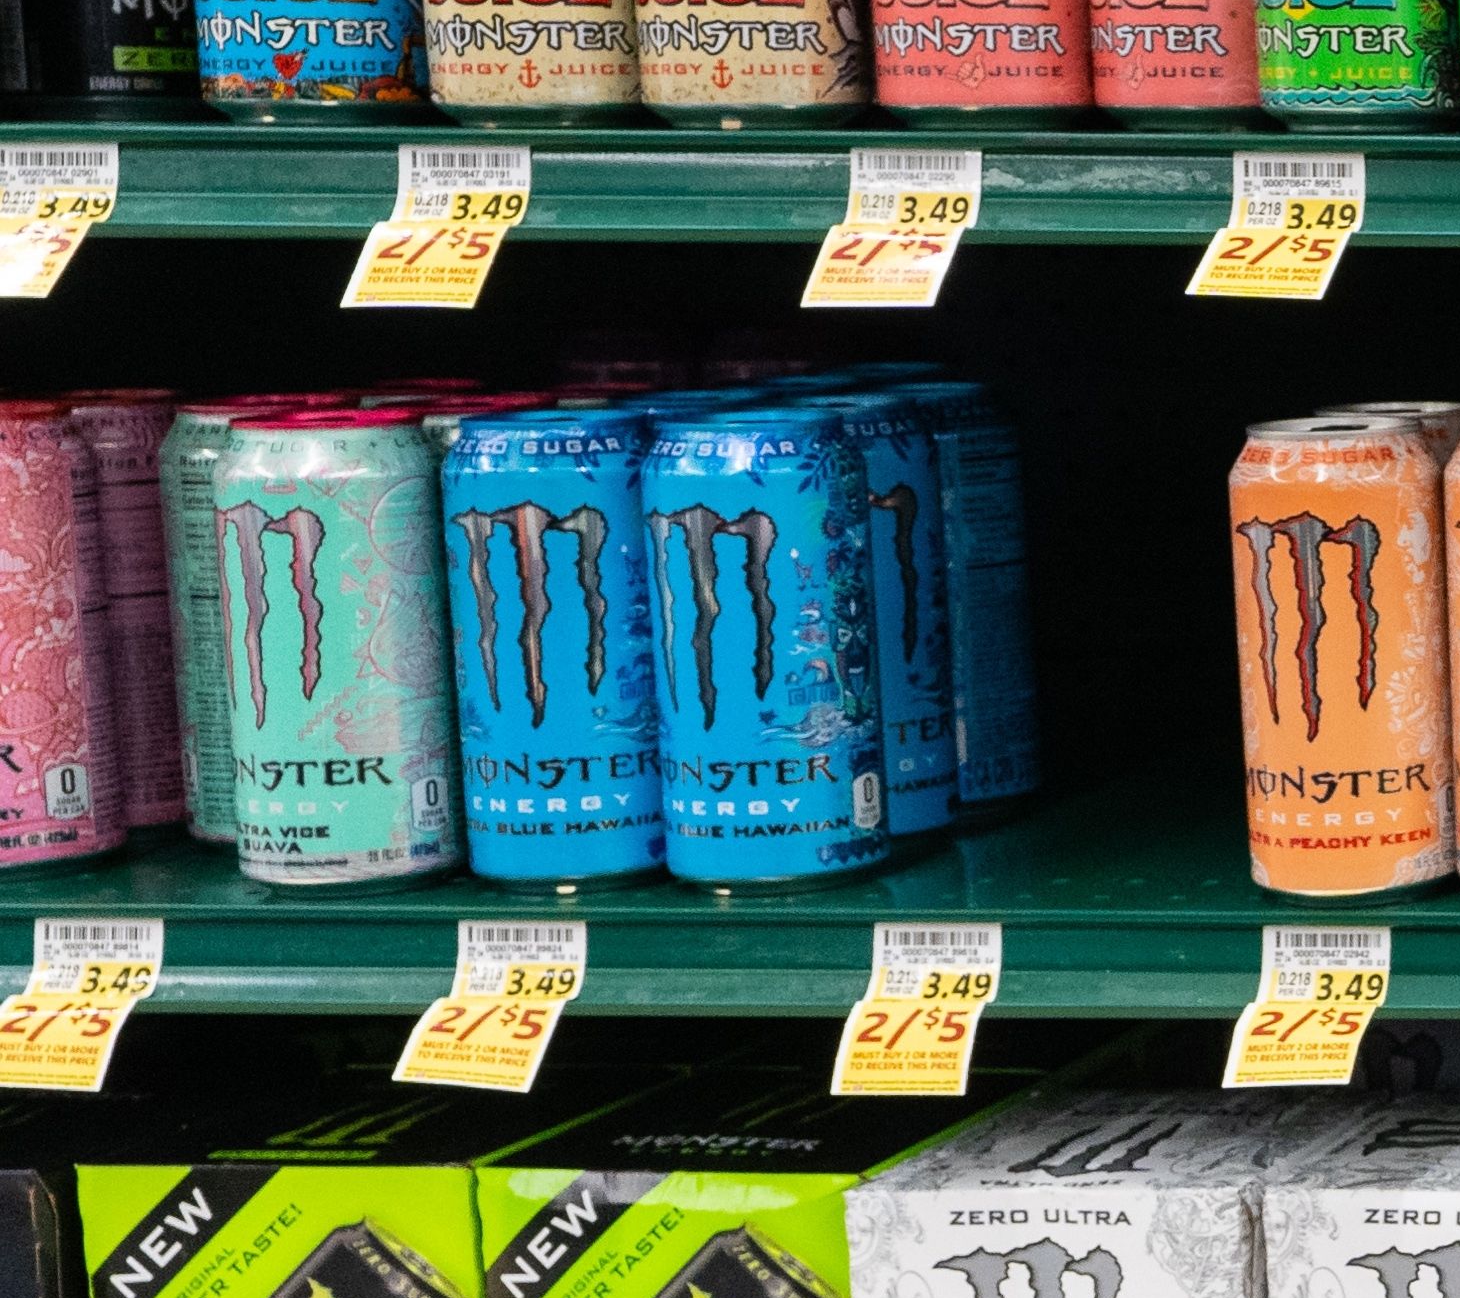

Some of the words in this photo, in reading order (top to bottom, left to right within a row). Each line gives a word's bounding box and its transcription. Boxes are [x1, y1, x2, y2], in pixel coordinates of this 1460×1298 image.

[451, 193, 523, 220] 3.49
[949, 1209, 1032, 1227] ZERO
[1043, 1209, 1130, 1227] ULTRA
